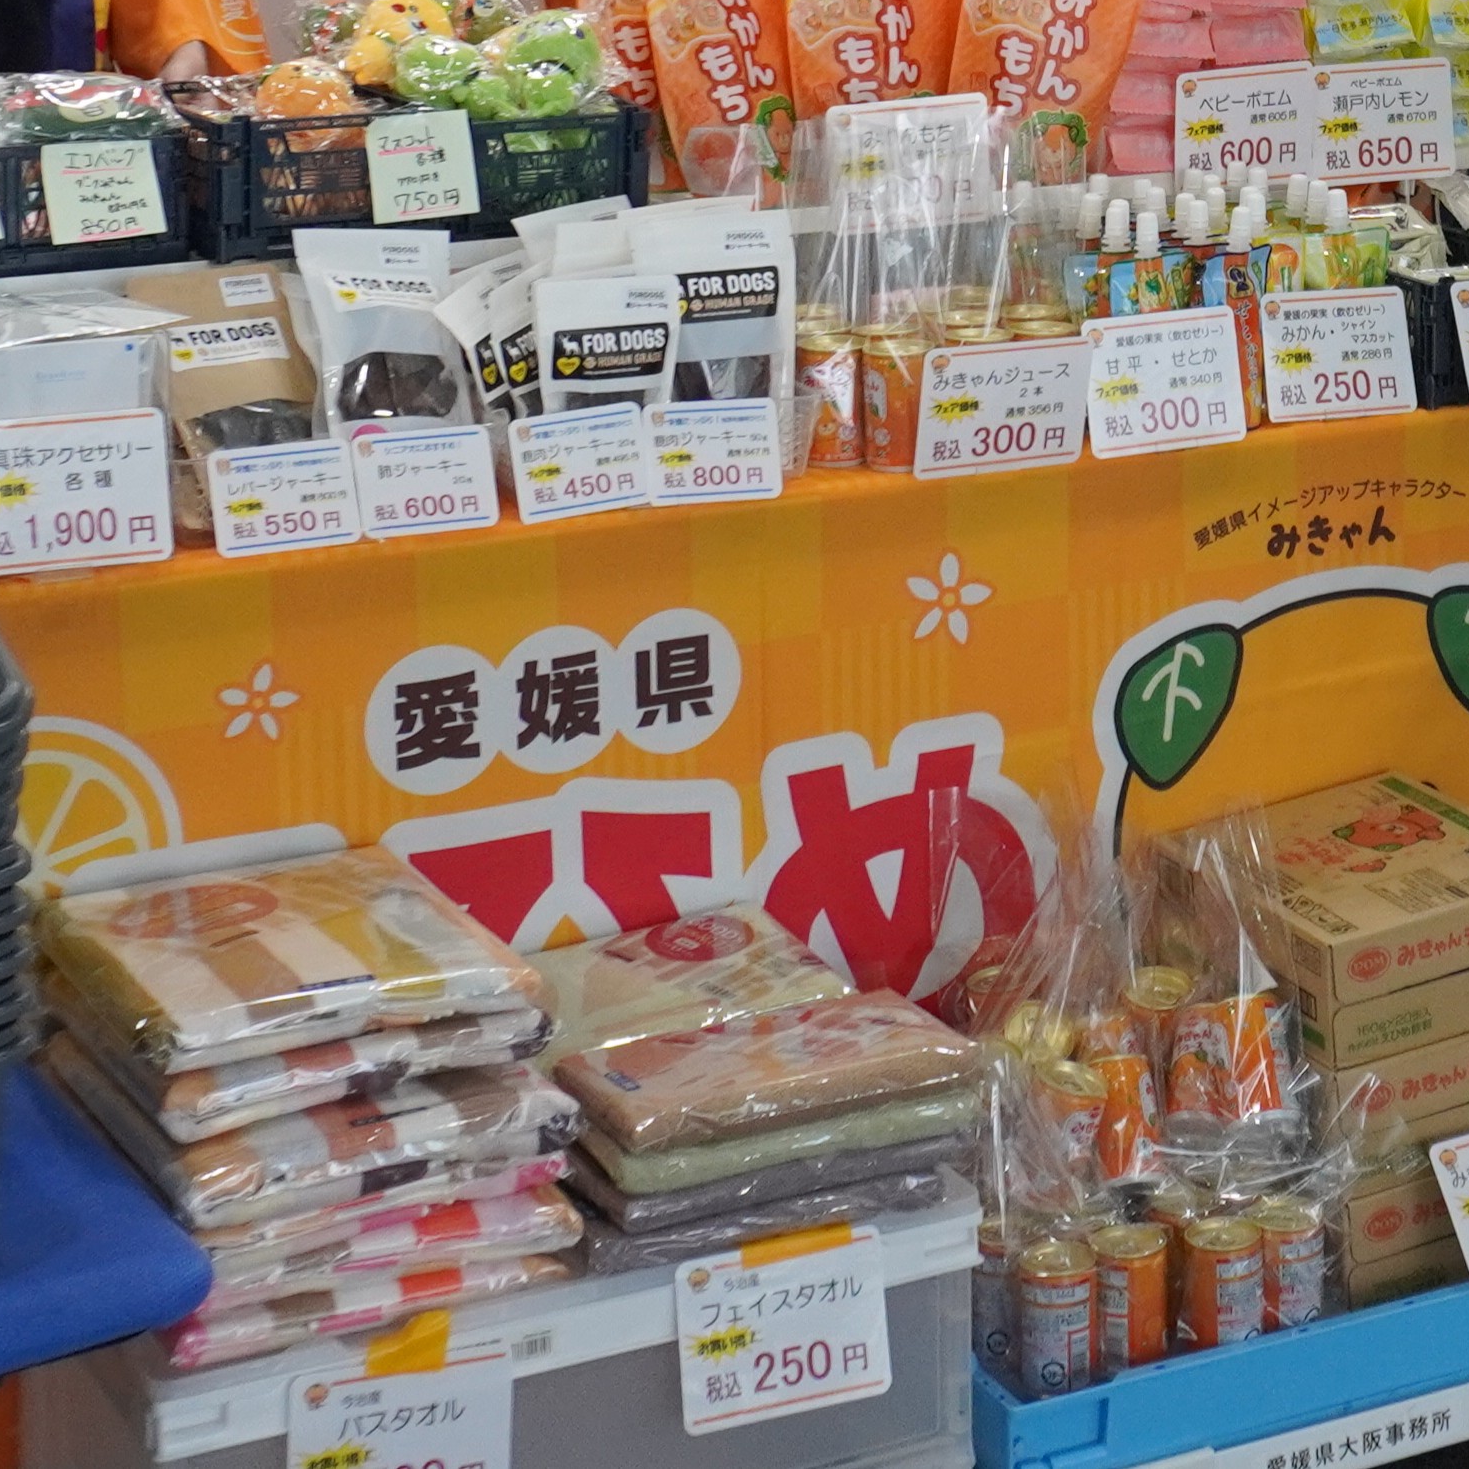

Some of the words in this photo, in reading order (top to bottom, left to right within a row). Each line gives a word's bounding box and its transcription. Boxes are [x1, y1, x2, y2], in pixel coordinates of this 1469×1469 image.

[699, 44, 750, 122] もち
[994, 35, 1035, 116] もち
[1350, 76, 1403, 89] ベビーポエム
[1199, 89, 1293, 114] ベビーポエム
[1332, 90, 1430, 114] 瀬戸内レモン
[1186, 122, 1224, 137] フェア価格
[1318, 121, 1359, 136] フェア価格
[1188, 153, 1213, 172] 税込
[1220, 137, 1273, 171] 600
[1279, 141, 1297, 163] 円
[1326, 150, 1351, 171] 税込
[1358, 137, 1413, 168] 650
[1419, 141, 1439, 164] 円
[394, 188, 461, 215] 750円
[80, 216, 139, 236] 850円
[349, 276, 381, 292] FOR
[384, 279, 433, 294] DOGS
[687, 276, 726, 298] FOR
[727, 270, 776, 294] DOGS
[1282, 303, 1387, 322] 愛媛の果実（飲むゼリー）
[1340, 319, 1377, 332] シャイン
[187, 327, 223, 346] FOR
[228, 320, 277, 341] DOGS
[582, 332, 621, 354] FOR
[622, 328, 668, 350] DOGS
[1350, 331, 1396, 345] マスカット
[1271, 351, 1314, 366] フェア価格
[932, 361, 1071, 393] みきゃんジュース
[1280, 383, 1308, 406] 税込
[1313, 370, 1372, 404] 250
[1378, 376, 1399, 399] 円
[1018, 385, 1044, 399] 2本
[1094, 381, 1140, 400] フェア価格
[932, 399, 980, 416] フェア価格
[1104, 413, 1135, 439] 税込
[1140, 396, 1201, 434] 300
[1207, 401, 1229, 426] 円
[932, 438, 962, 463] 税込
[971, 420, 1037, 459] 300
[1043, 425, 1066, 451] 円
[63, 470, 115, 492] 各種
[226, 472, 343, 497] レバージャーキー
[563, 473, 612, 500] 450
[618, 471, 635, 492] 円
[692, 463, 741, 488] 800
[746, 465, 764, 484] 円
[404, 494, 455, 519] 600
[461, 494, 480, 514] 円
[1192, 478, 1467, 552] 愛媛県イメージアップキャラクター
[23, 507, 118, 553] 1,900
[129, 514, 158, 544] 円
[264, 510, 316, 536] 550
[323, 510, 342, 530] 円
[1266, 506, 1397, 560] みきゃん
[394, 633, 714, 773] 愛媛県
[700, 1276, 864, 1330] フェイスタオル
[706, 1371, 743, 1404] 税込
[753, 1339, 833, 1394] 250
[842, 1342, 869, 1374] 円
[337, 1398, 467, 1442] バスタオル
[1266, 1408, 1452, 1469] 愛媛県大阪事務所
